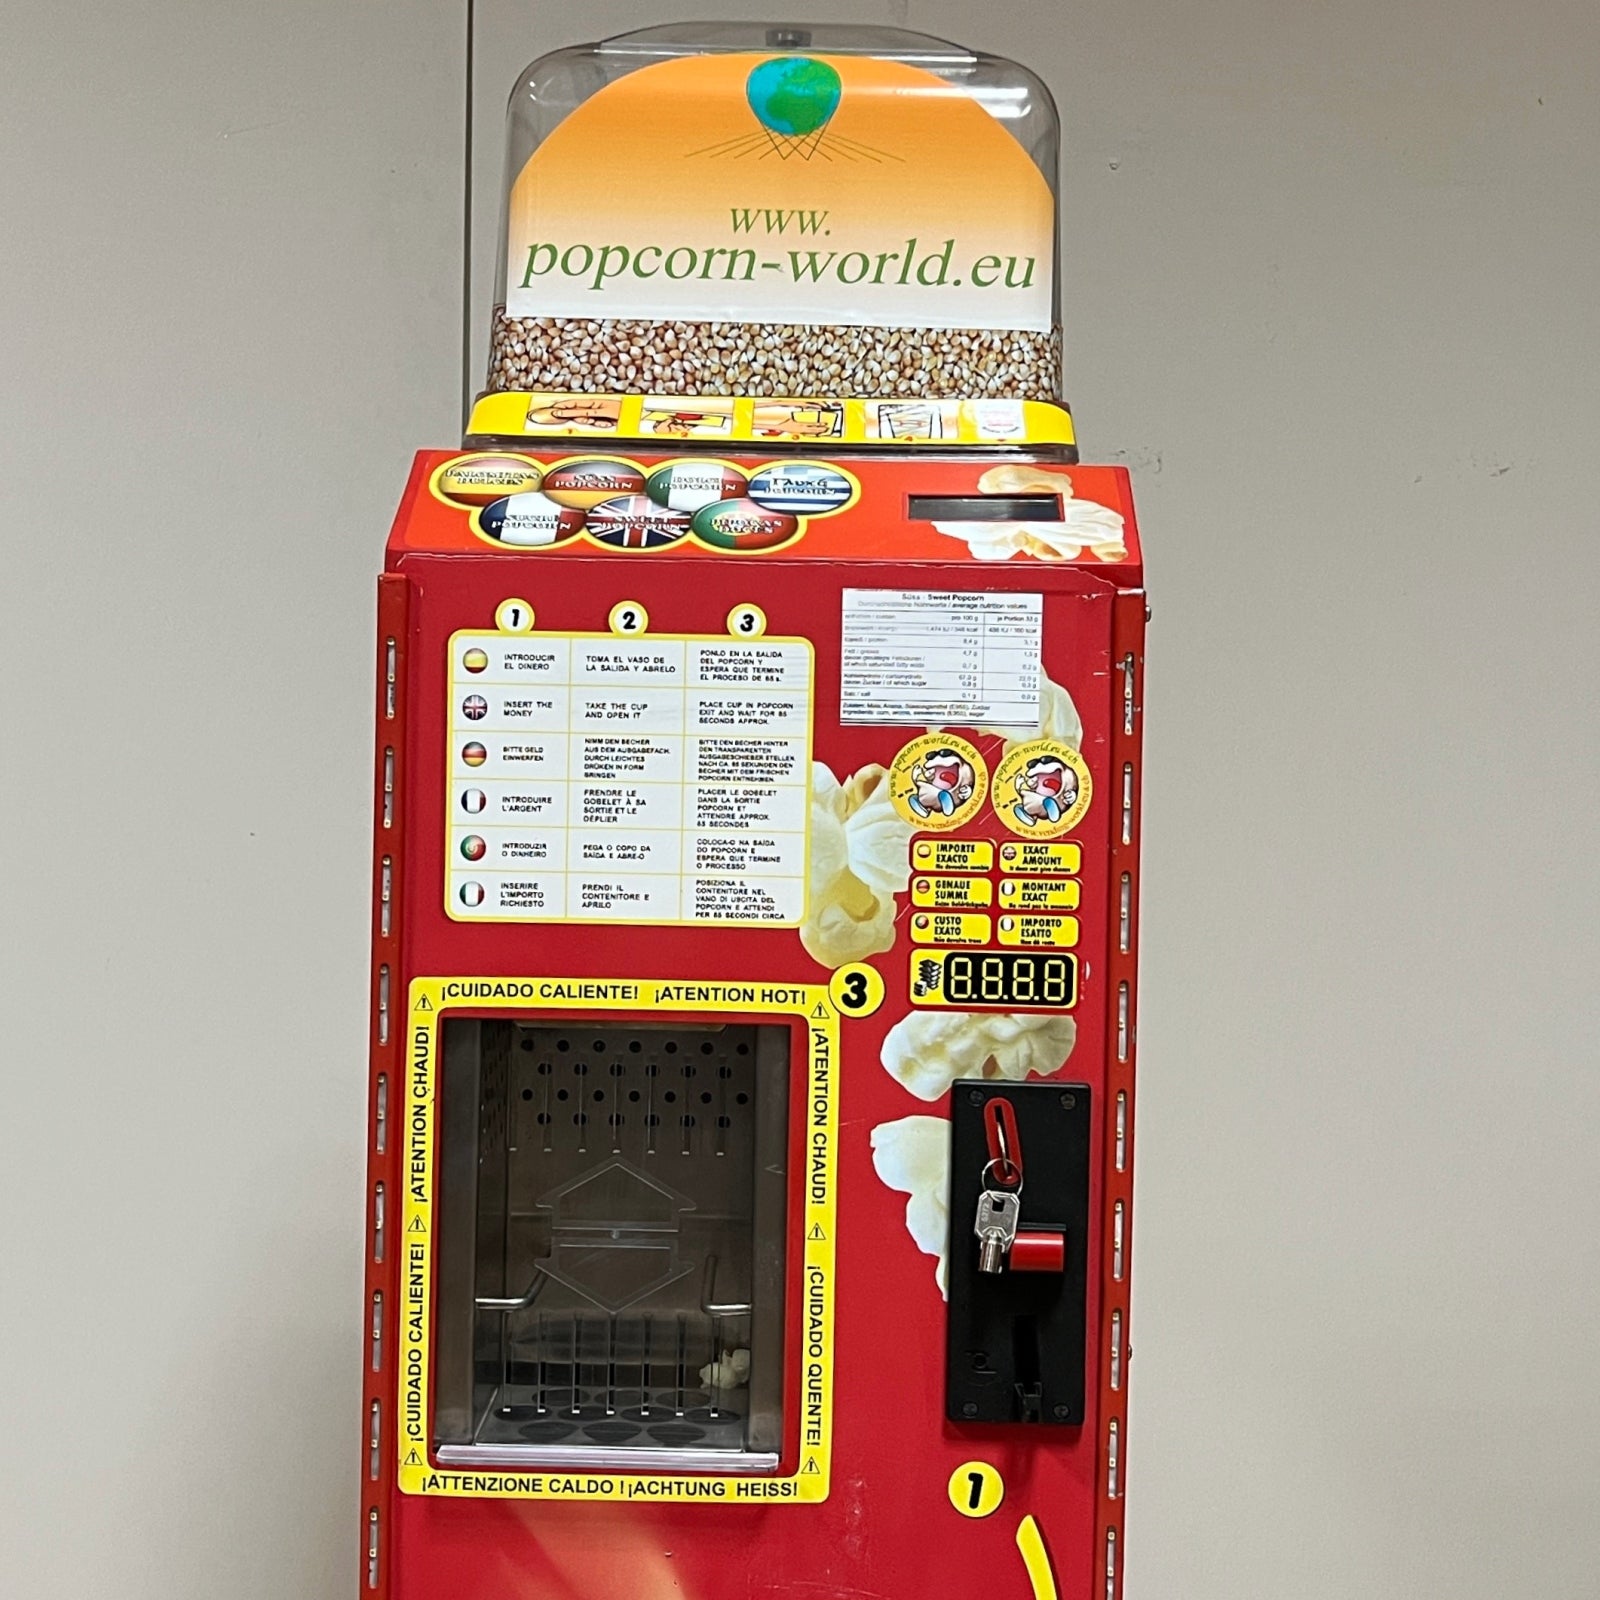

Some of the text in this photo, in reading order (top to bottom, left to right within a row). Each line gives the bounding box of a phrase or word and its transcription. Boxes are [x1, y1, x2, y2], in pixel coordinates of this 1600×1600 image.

[730, 208, 832, 236] www.
[518, 238, 1036, 290] popcorn-world.eu
[555, 481, 632, 489] POPCORN
[491, 521, 572, 530] POPCORN
[512, 609, 520, 627] 1
[623, 612, 636, 629] 2
[740, 614, 754, 632] 3
[936, 844, 975, 853] IMPORTE
[1023, 846, 1049, 854] EXACT
[936, 855, 968, 863] EXACTO
[1022, 856, 1062, 865] AMOUNT
[935, 881, 970, 889] GENAUE
[1022, 882, 1066, 891] MONTANT
[935, 891, 968, 899] SUMME
[1022, 893, 1048, 901] EXACT
[934, 917, 961, 925] CUSTO
[1021, 918, 1062, 927] IMPORTO
[934, 927, 961, 935] EXATO
[1021, 929, 1052, 937] ESATTO
[442, 983, 638, 1001] ¡CUIDADO CALIENTE!
[654, 986, 806, 1004] ¡ATENTION HOT!
[842, 972, 868, 1008] 3
[411, 1026, 430, 1203] ¡ATENTION CHAUD!
[811, 1028, 829, 1204] ¡ATENTION CHAUD!
[406, 1243, 425, 1442] ¡CUIDADO CALIENTE!
[807, 1266, 824, 1446] ¡CUIDADO QUENTE!
[422, 1475, 543, 1493] ¡ATTENZIONE
[548, 1478, 614, 1495] CALDO
[628, 1480, 798, 1498] ¡ACHTUNG HEISS!
[968, 1472, 983, 1509] 1
